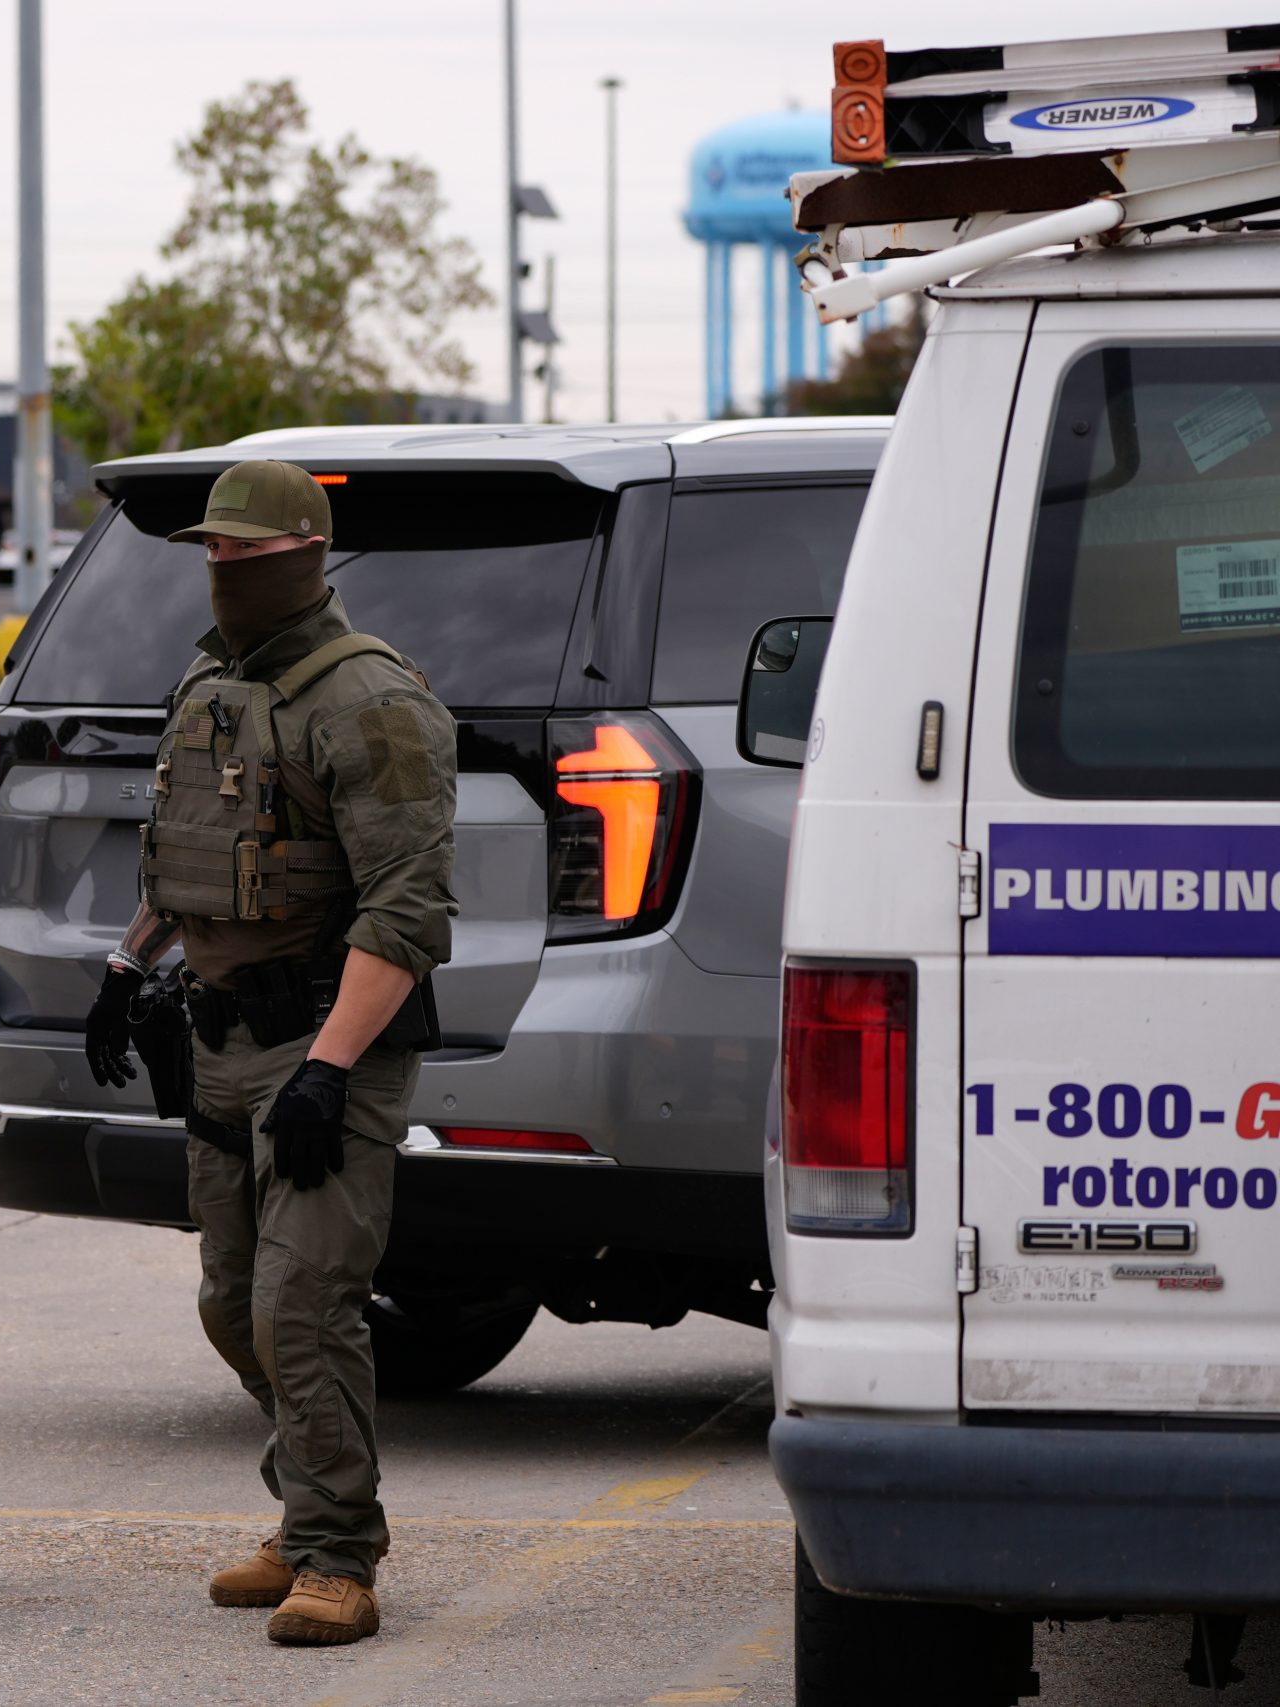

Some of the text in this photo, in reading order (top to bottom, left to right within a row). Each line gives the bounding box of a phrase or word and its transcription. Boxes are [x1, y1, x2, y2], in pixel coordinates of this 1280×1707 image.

[1047, 103, 1156, 125] WERNER
[1022, 1222, 1191, 1250] E-150
[1158, 1276, 1224, 1290] RSC
[1023, 1292, 1097, 1302] MNDEVILLE
